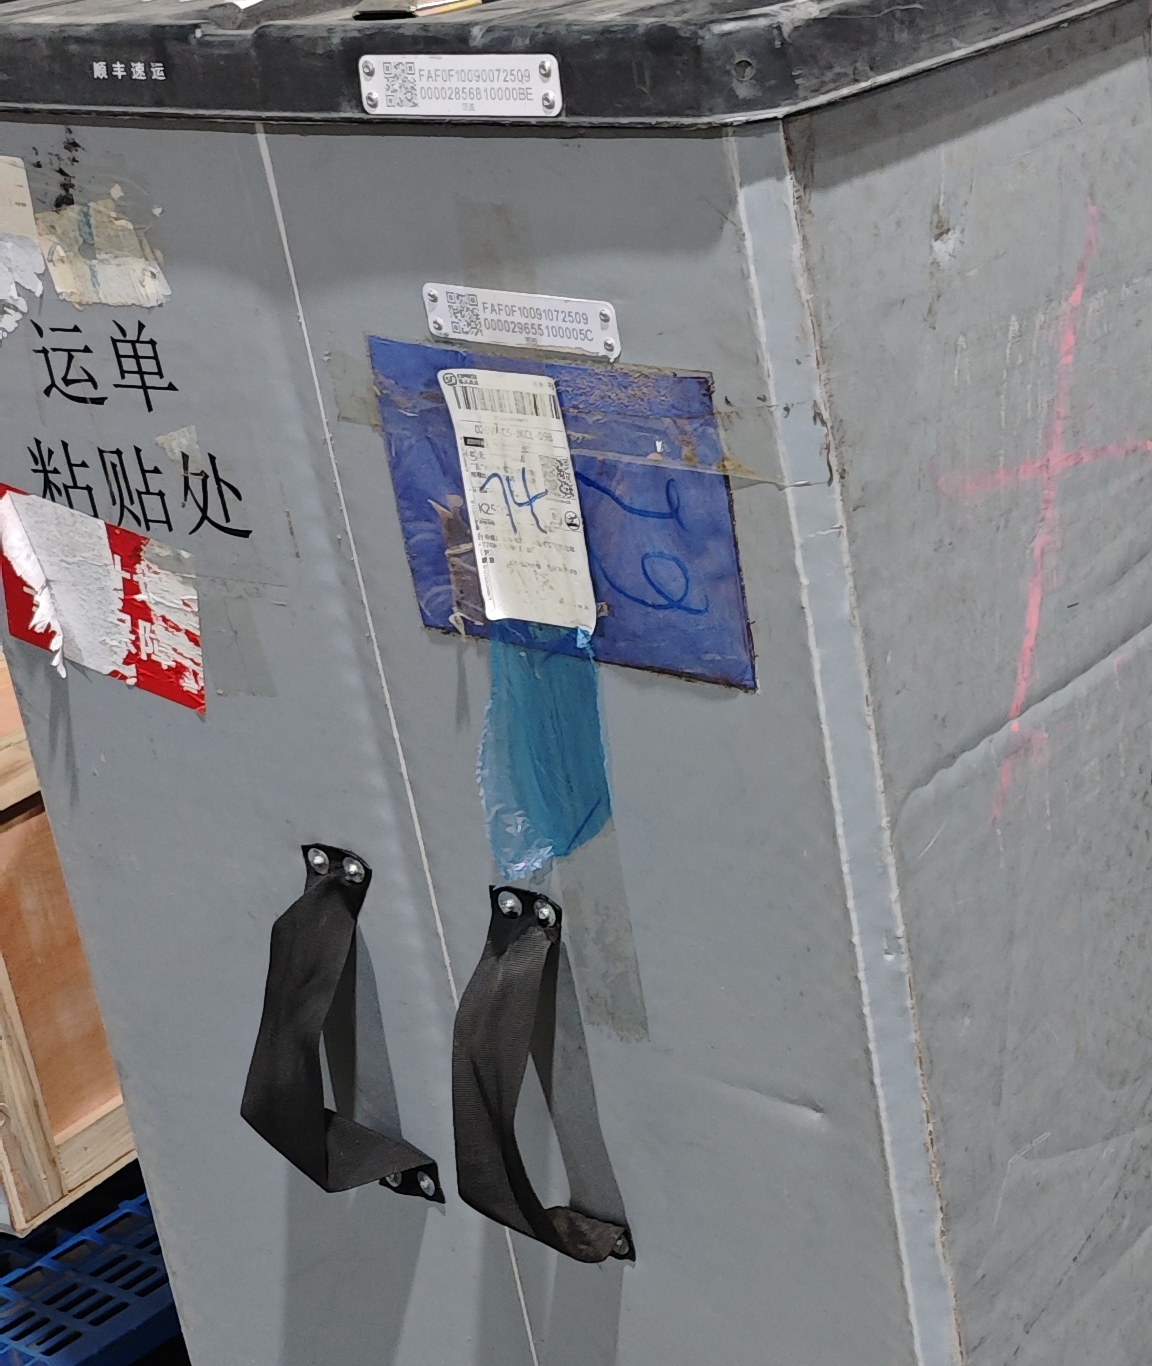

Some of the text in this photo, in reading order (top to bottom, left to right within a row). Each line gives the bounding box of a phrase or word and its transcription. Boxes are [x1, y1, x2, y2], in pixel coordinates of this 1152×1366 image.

[93, 61, 166, 80] 顺丰速运
[482, 302, 589, 325] FAF0F10091072509
[30, 319, 179, 413] 运单
[27, 437, 253, 539] 粘贴处
